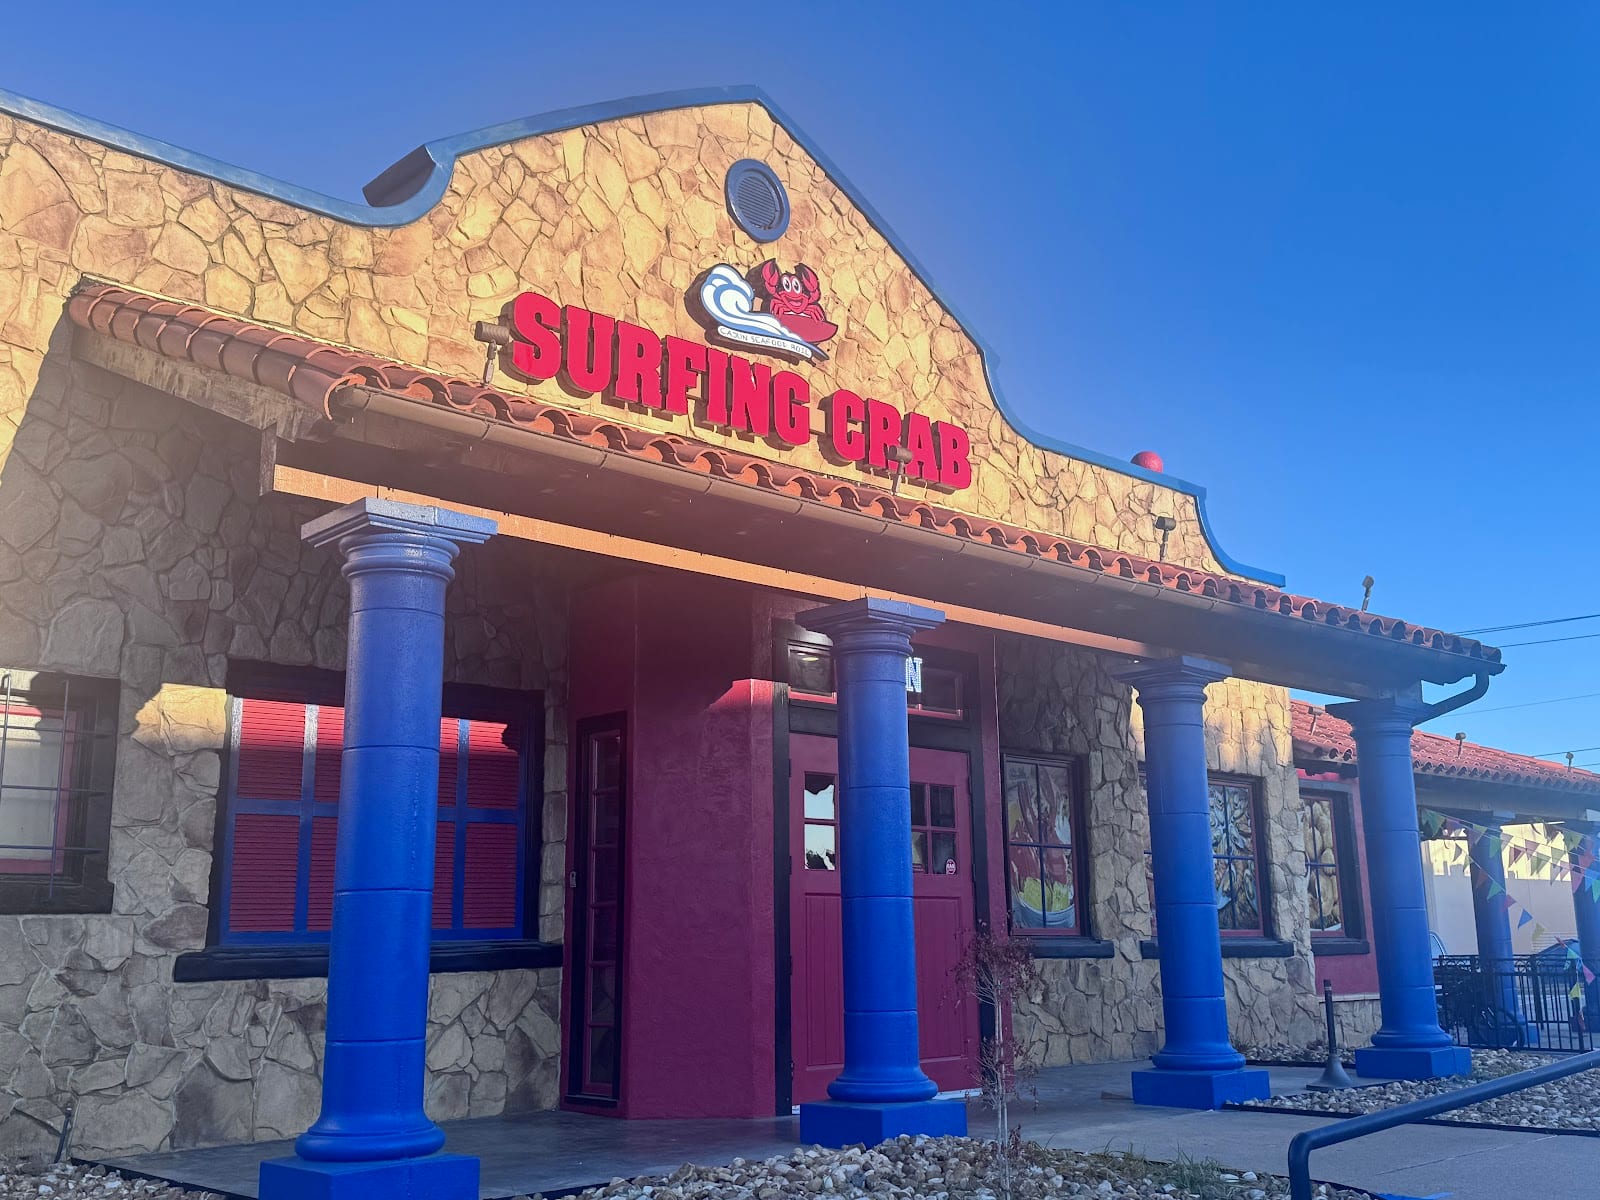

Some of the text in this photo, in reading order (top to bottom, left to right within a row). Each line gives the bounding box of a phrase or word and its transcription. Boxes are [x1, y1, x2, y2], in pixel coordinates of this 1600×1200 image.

[719, 327, 748, 342] CAJUN
[512, 291, 972, 490] SURFING CRAB
